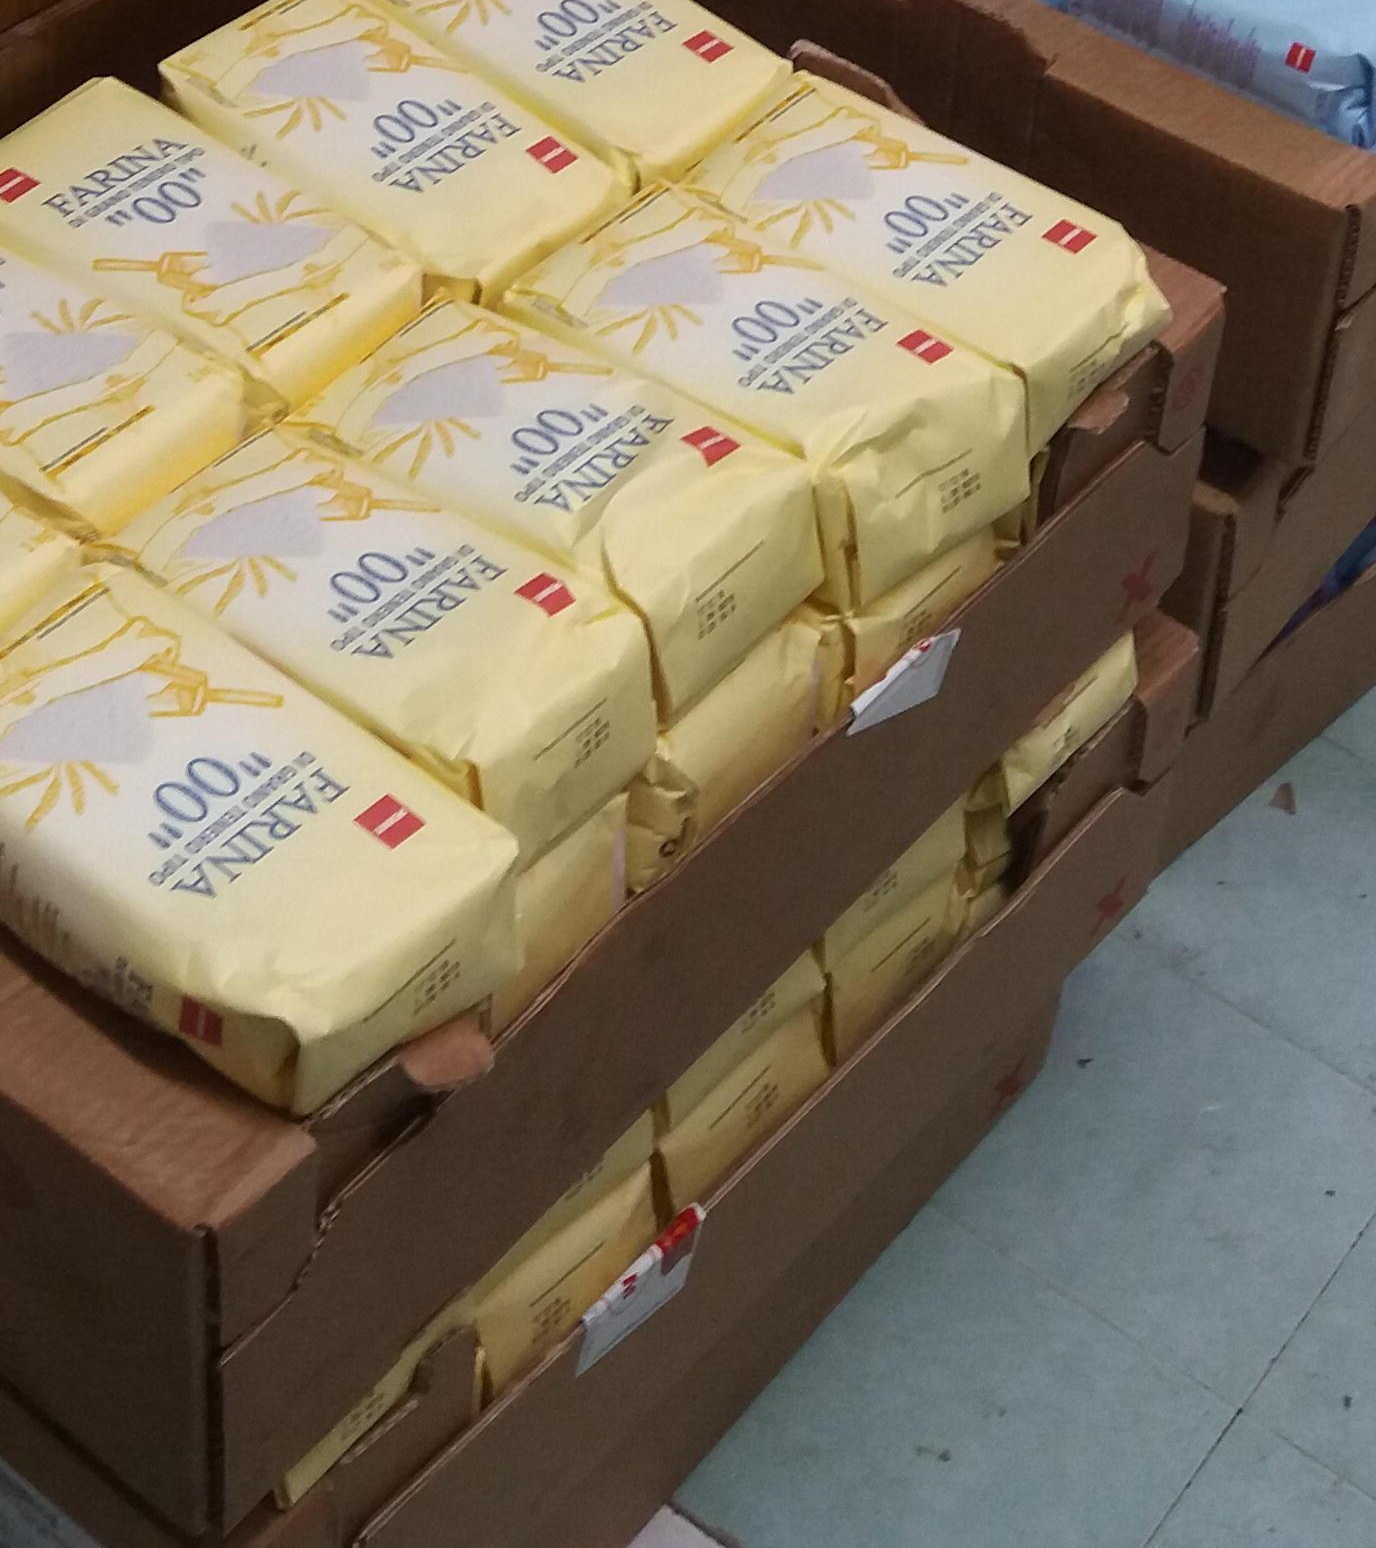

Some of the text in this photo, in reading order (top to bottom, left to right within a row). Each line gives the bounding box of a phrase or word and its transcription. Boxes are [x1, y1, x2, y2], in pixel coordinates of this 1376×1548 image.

[551, 11, 679, 84] FARINA
[41, 138, 190, 218] FARINA
[389, 113, 522, 192] FARINA
[911, 203, 1034, 288] FARINA
[756, 308, 889, 394] FARINA
[534, 413, 676, 512] FARINA
[350, 554, 509, 659] FARINA
[170, 766, 351, 898] FARINA
